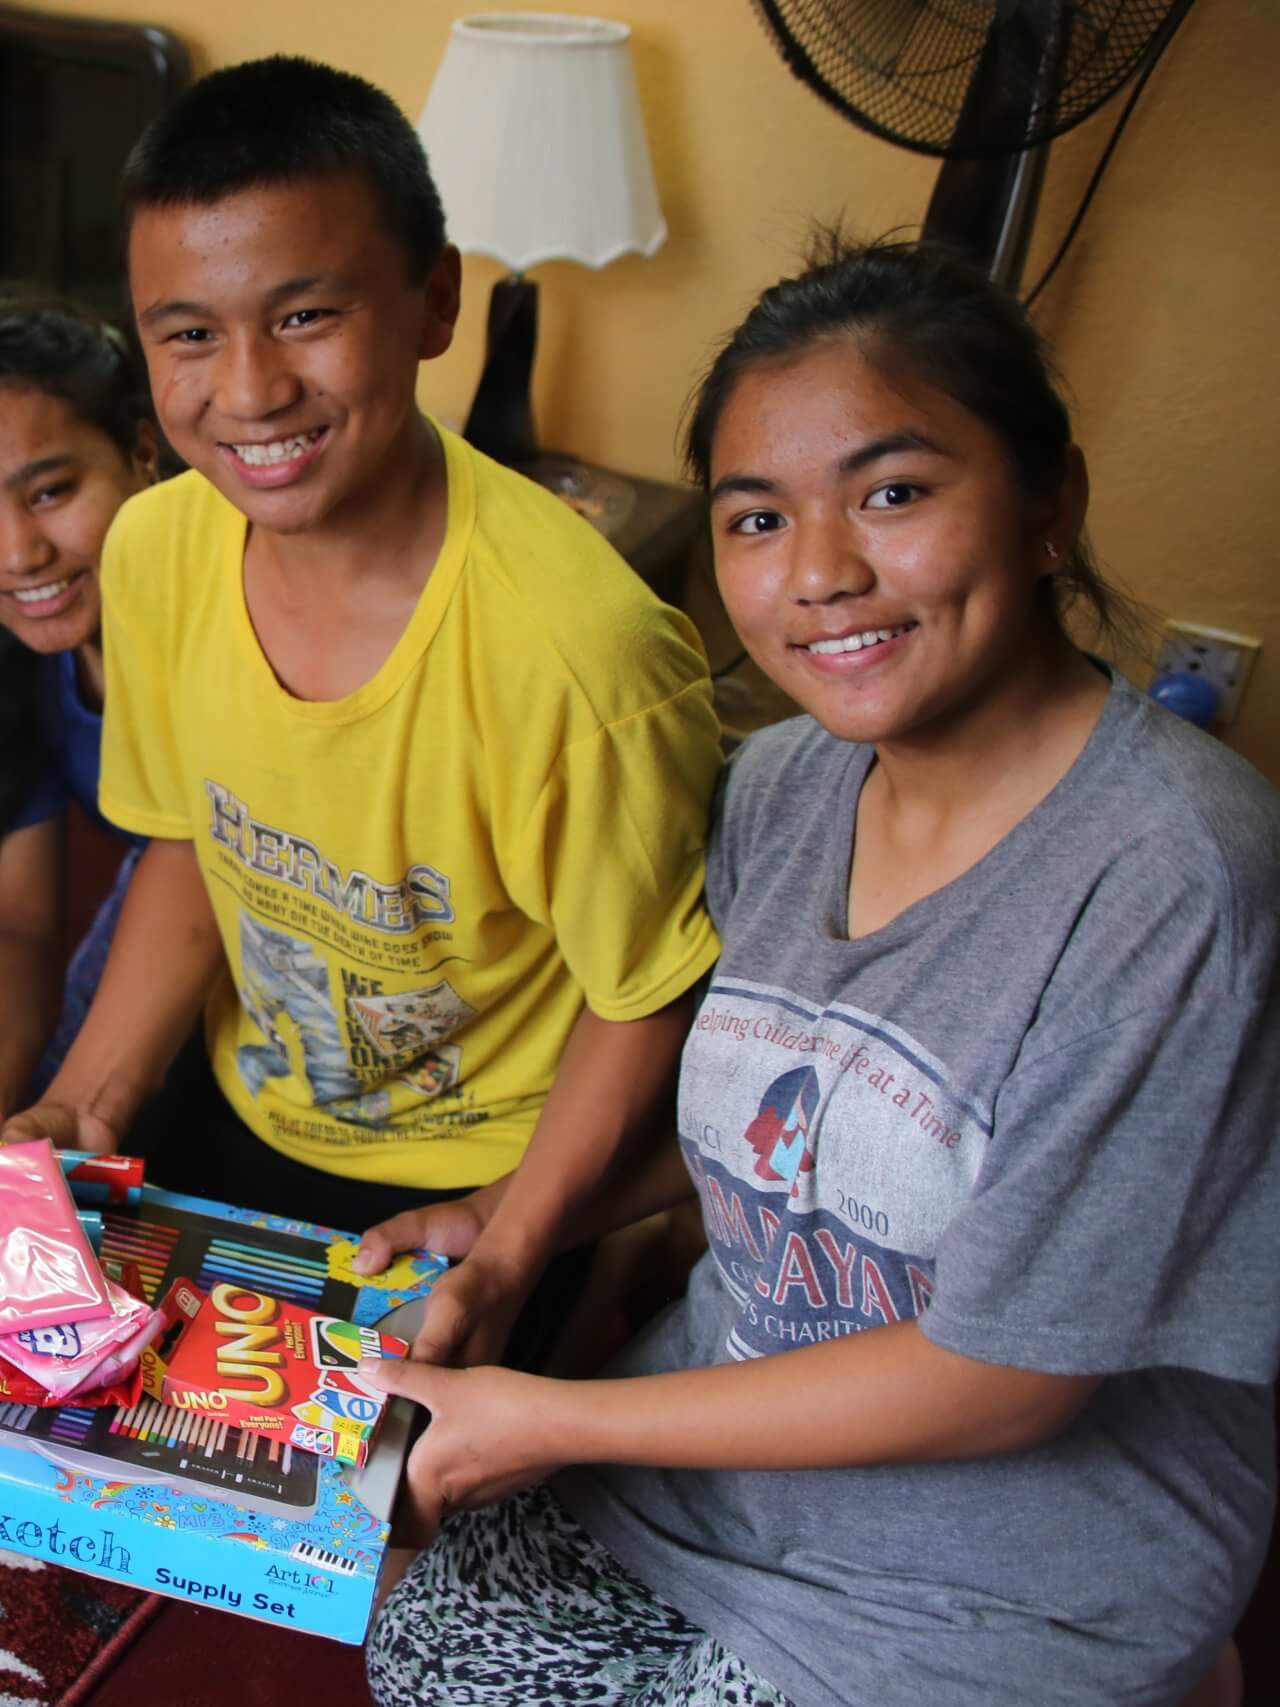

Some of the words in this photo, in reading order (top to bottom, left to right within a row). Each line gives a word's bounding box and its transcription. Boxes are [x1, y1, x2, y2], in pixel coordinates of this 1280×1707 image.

[205, 777, 455, 935] HERMES
[384, 941, 419, 955] GOES
[388, 955, 422, 968] TIME
[867, 1068, 895, 1095] at
[891, 1086, 912, 1109] a
[910, 1091, 962, 1149] Time
[836, 1188, 890, 1237] 2000
[211, 1283, 286, 1408] UNO
[143, 1351, 157, 1389] UNO
[171, 1391, 228, 1410] UNO
[240, 1419, 283, 1430] Everyone!
[154, 1567, 242, 1608] Supply
[252, 1592, 297, 1619] Set
[263, 1564, 301, 1585] Art
